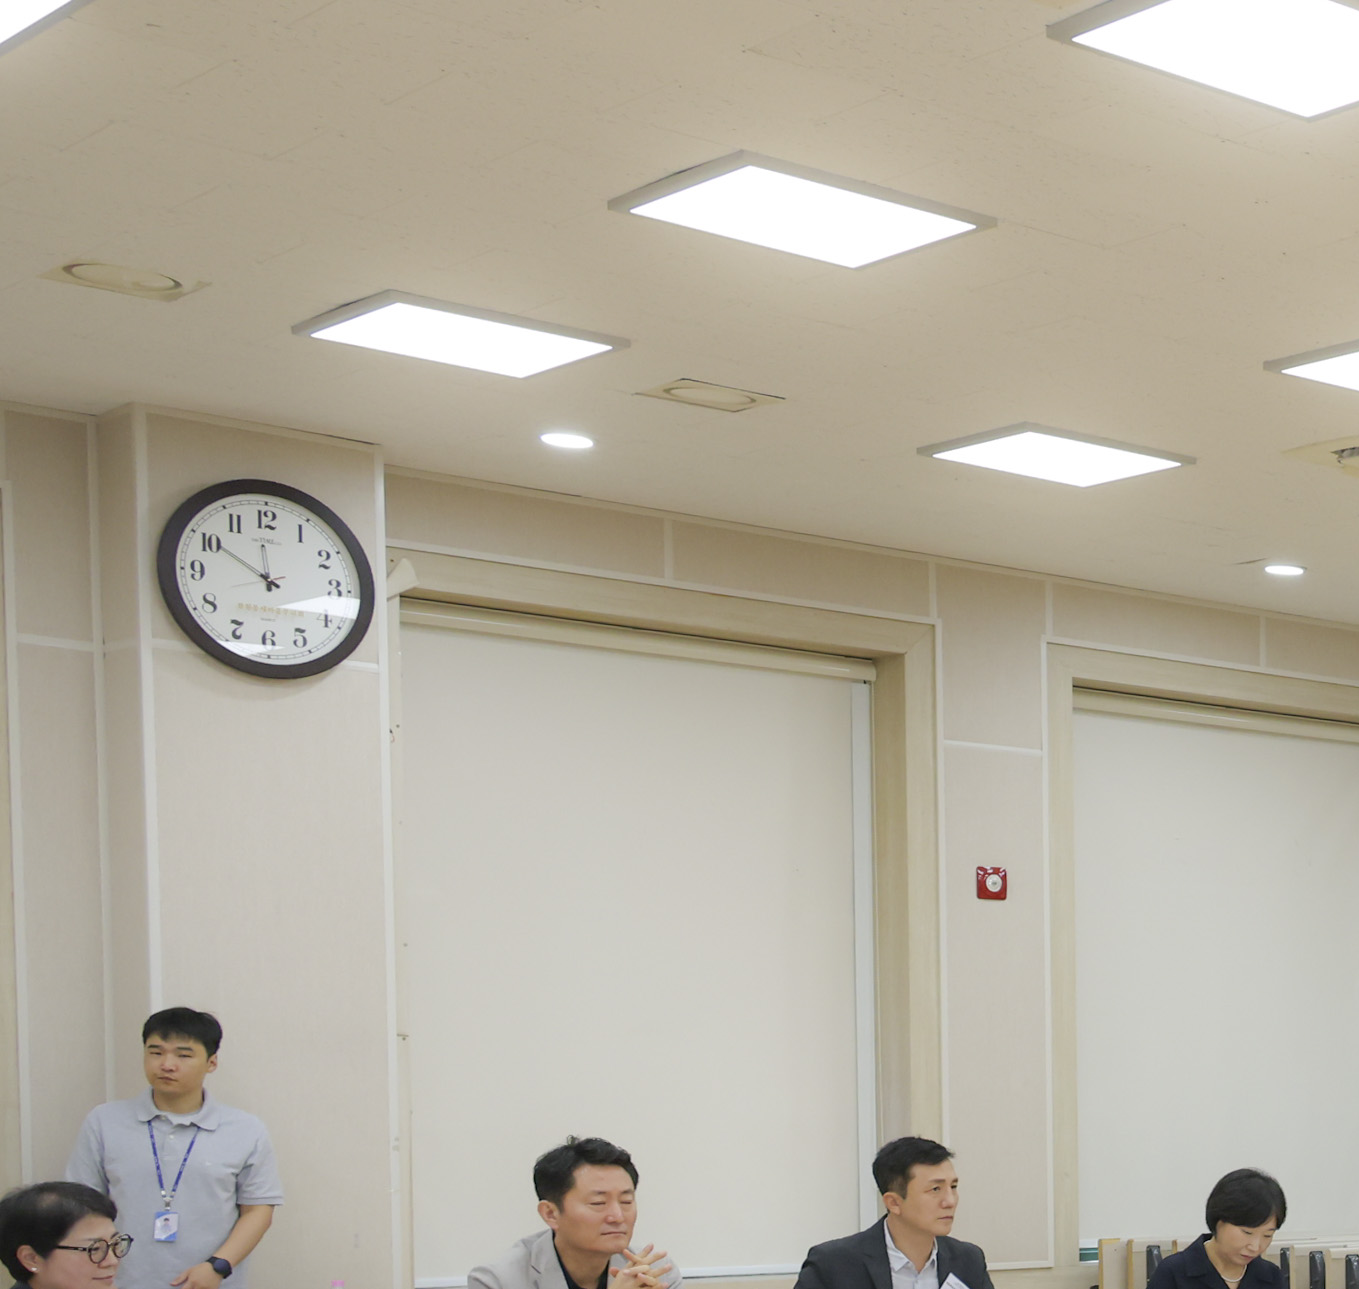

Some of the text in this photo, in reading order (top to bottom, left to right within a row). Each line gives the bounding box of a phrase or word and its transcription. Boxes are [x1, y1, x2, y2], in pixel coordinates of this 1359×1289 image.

[228, 513, 242, 534] 11
[257, 509, 277, 531] 12
[201, 532, 221, 553] 10
[297, 524, 304, 543] 1
[190, 559, 205, 581] 9
[318, 550, 331, 569] 2
[327, 579, 342, 600] 3
[202, 593, 218, 613] 8
[316, 609, 332, 628] 4
[230, 619, 244, 640] 7
[262, 630, 276, 650] 6
[293, 627, 307, 648] 5
